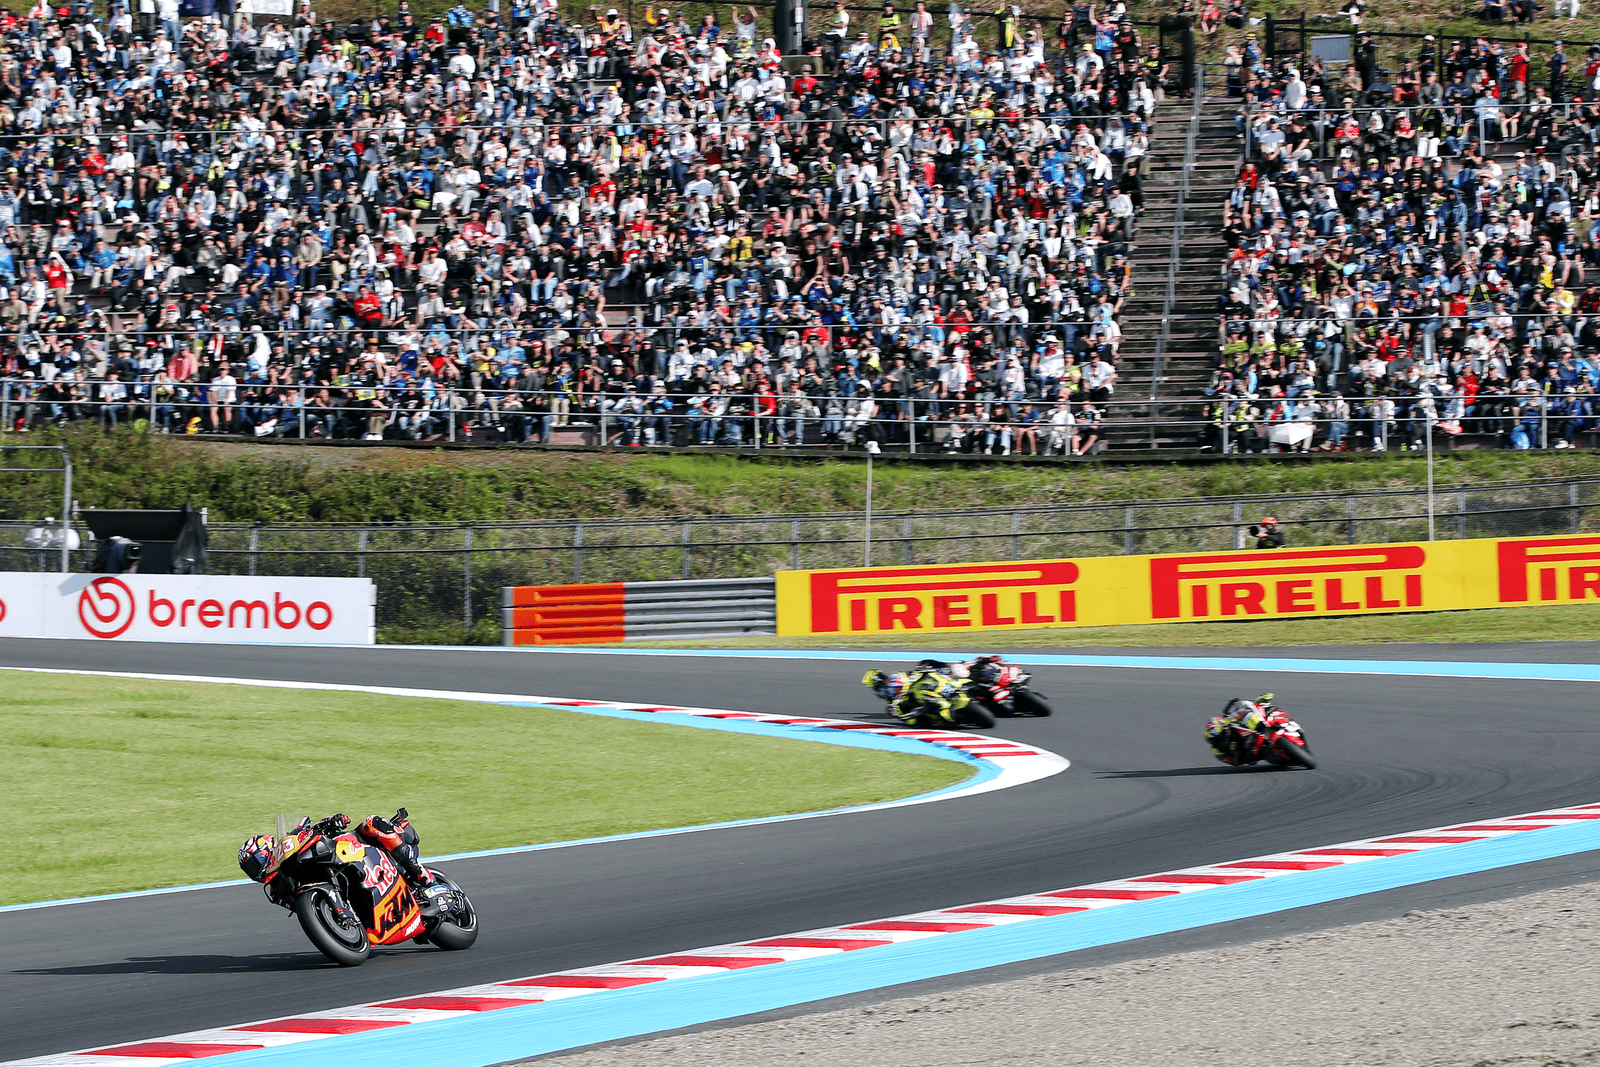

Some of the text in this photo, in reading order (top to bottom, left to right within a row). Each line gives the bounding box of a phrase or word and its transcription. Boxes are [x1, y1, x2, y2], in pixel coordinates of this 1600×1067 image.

[150, 590, 332, 630] brembo
[811, 562, 1079, 632] PIRELLI
[1150, 546, 1425, 619] PIRELLI
